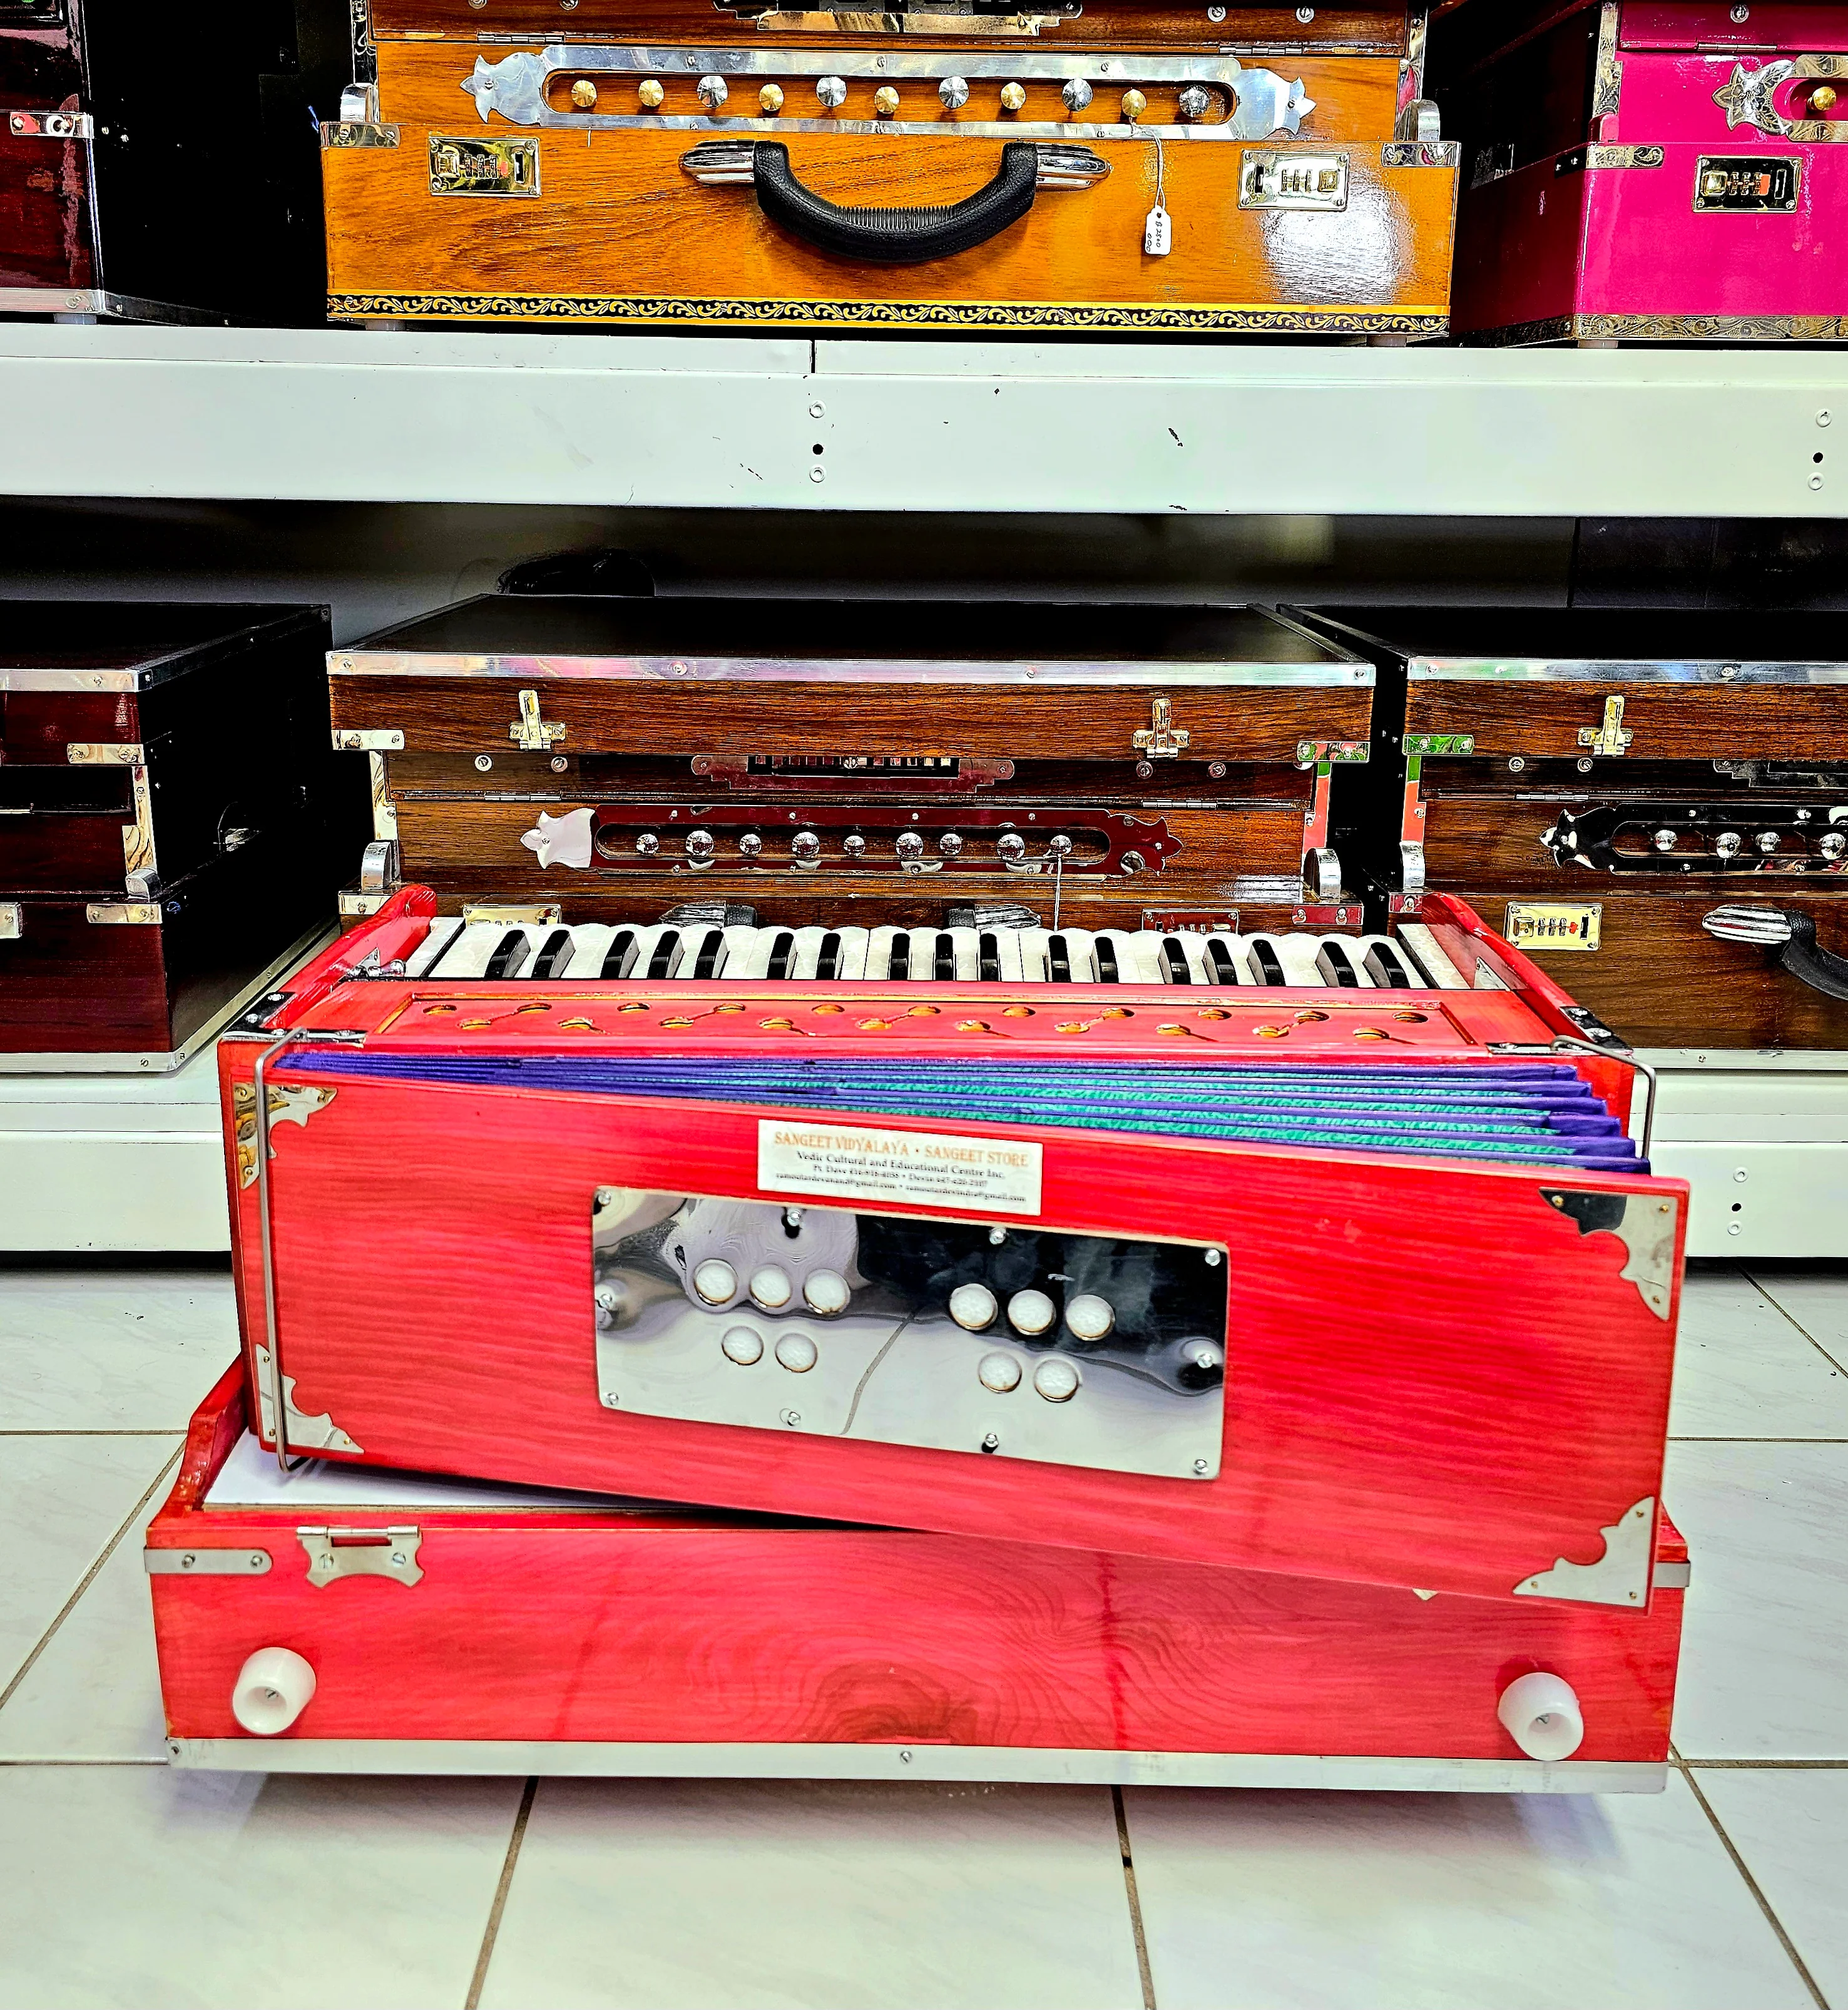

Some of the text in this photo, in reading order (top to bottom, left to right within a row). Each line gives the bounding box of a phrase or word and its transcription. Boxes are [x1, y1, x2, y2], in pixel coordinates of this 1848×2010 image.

[774, 1131, 1029, 1167] SANGEET VIDYALAYA SANGEET STORE
[796, 1150, 1006, 1179] Vedic Cultural and Educational Centre Inc.
[826, 1165, 847, 1174] Dave
